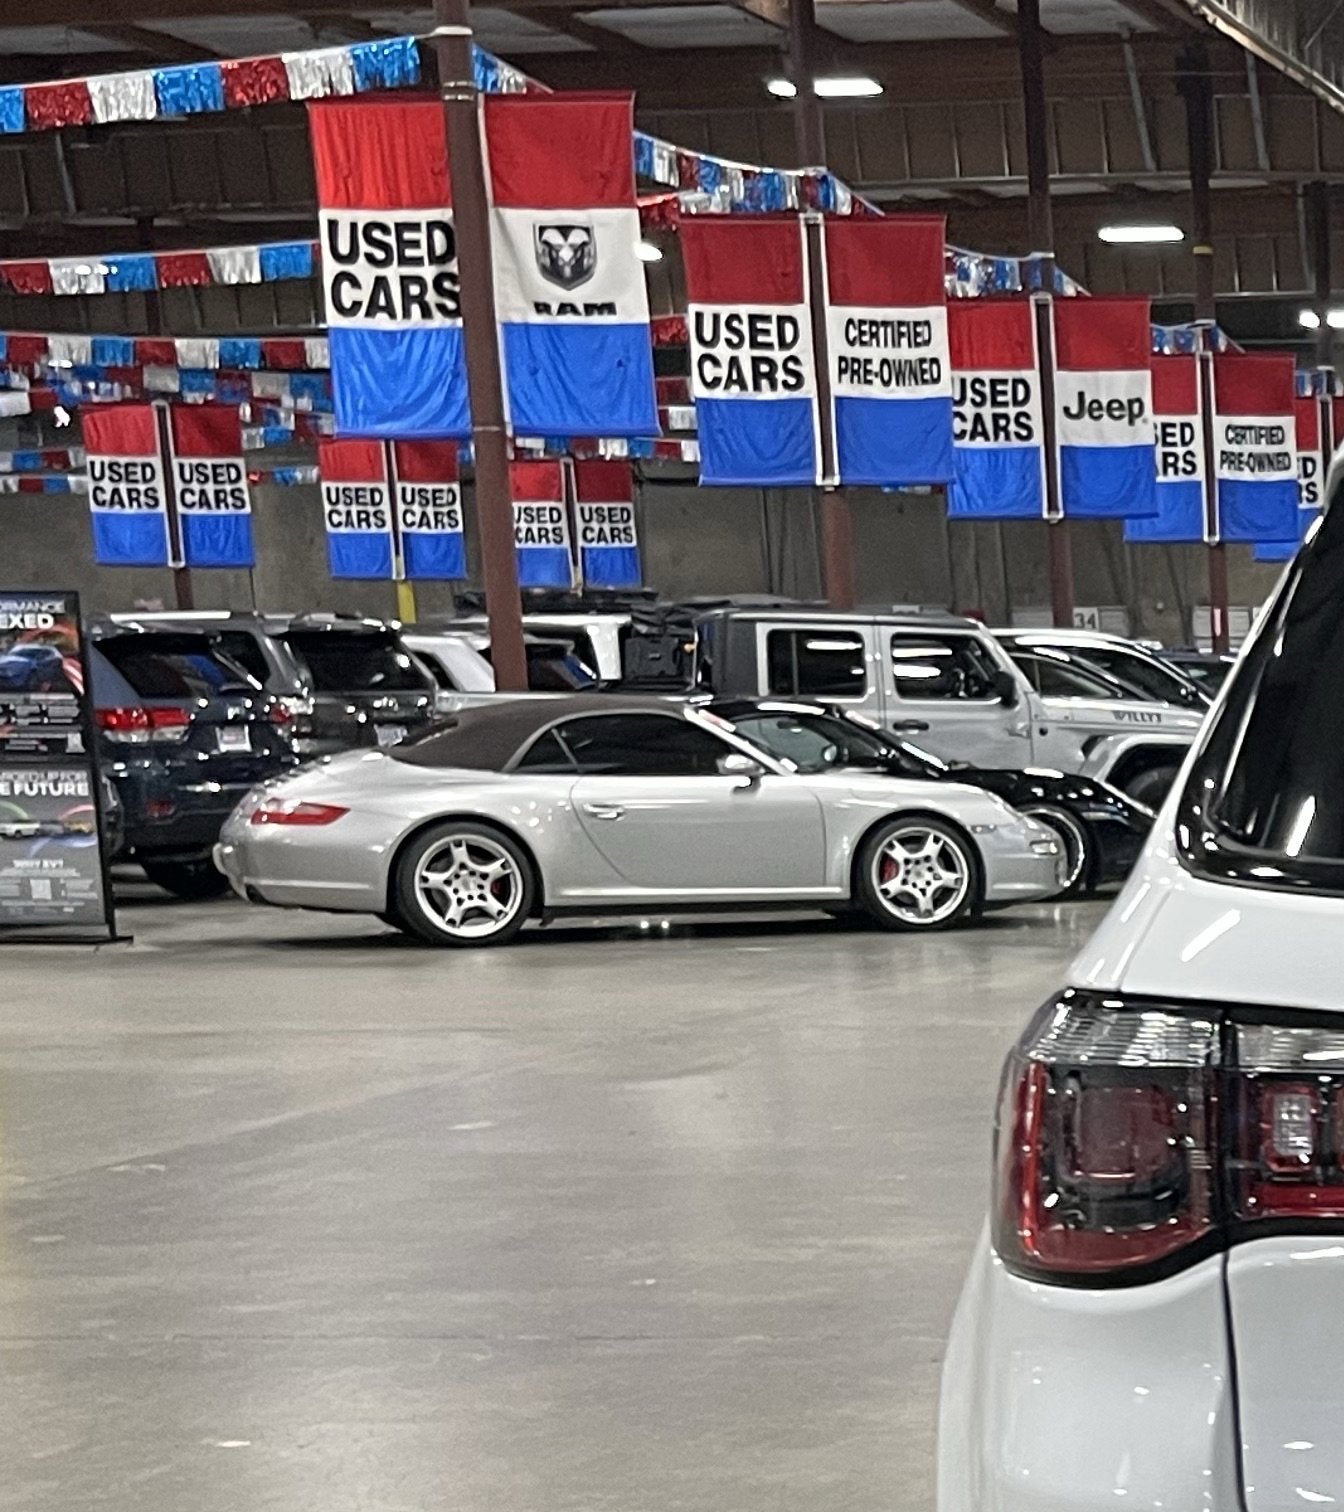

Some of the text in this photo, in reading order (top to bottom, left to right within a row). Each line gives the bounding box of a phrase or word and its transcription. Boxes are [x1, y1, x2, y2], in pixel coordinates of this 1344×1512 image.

[327, 219, 456, 268] USED
[330, 270, 462, 321] CARS
[534, 301, 617, 316] RAM
[695, 311, 800, 351] USED
[845, 318, 932, 349] CERTIFIED
[697, 353, 805, 393] CARS
[838, 355, 942, 388] PRE-OWNED
[952, 377, 1031, 408] USED
[1063, 391, 1145, 426] Jeep
[953, 411, 1034, 442] CARS
[1225, 424, 1286, 445] CERTIFIED
[90, 461, 156, 484] USED
[1219, 450, 1292, 472] PRE-OWNED
[179, 462, 242, 485] USED
[93, 486, 160, 509] CARS
[180, 487, 246, 510] CARS
[326, 486, 384, 507] USED
[402, 486, 457, 508] USED
[327, 509, 386, 529] CARS
[402, 509, 459, 530] CARS
[580, 506, 632, 524] USED
[582, 526, 633, 544] CARS
[1075, 613, 1097, 629] 34
[14, 781, 89, 797] FUTURE
